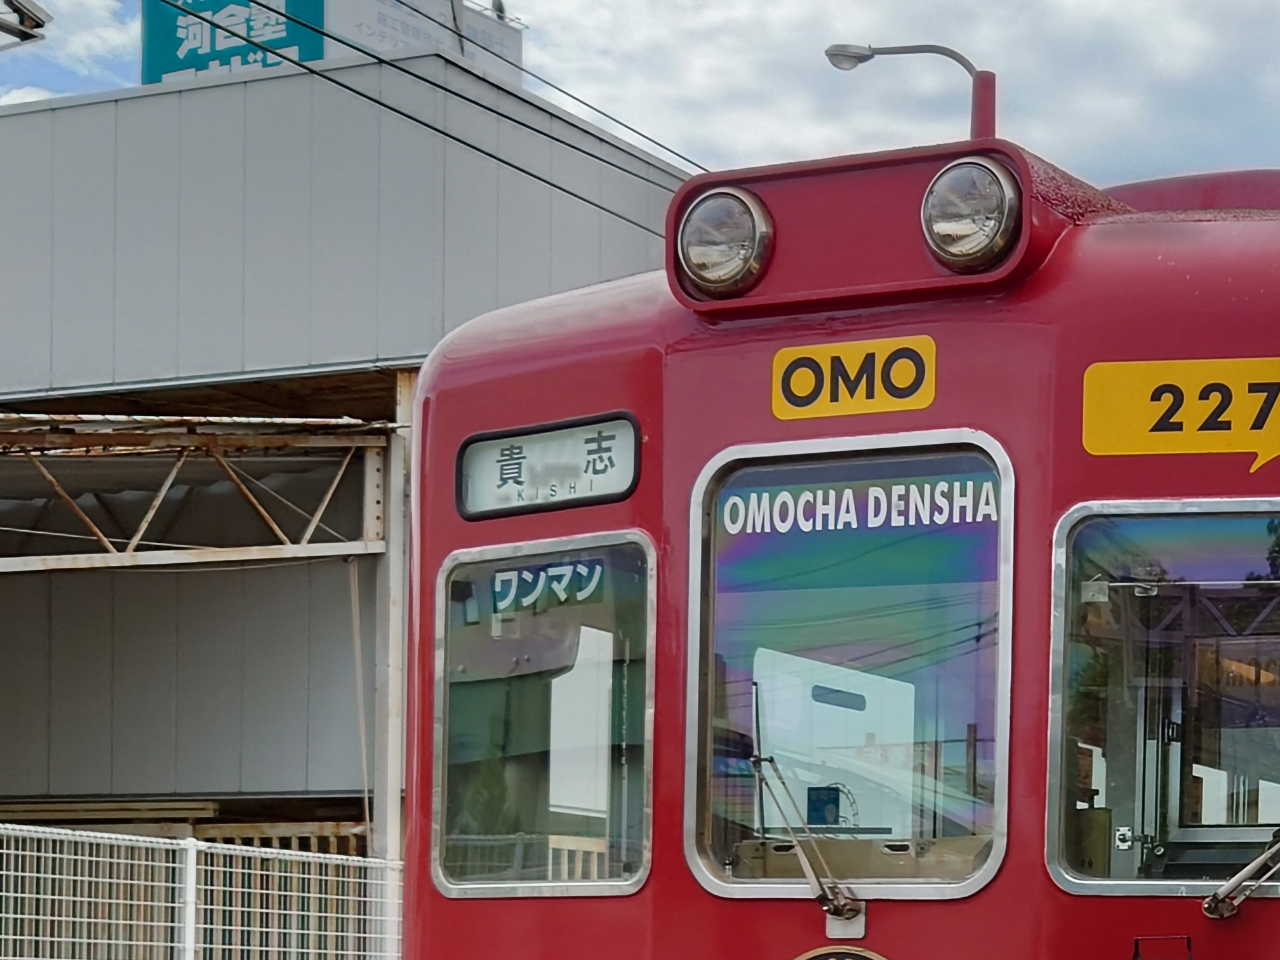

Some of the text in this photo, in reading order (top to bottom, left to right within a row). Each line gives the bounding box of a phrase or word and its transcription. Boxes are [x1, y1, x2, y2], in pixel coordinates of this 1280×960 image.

[176, 0, 287, 59] 河合塾
[781, 347, 926, 407] OMO
[517, 479, 594, 502] KISHI
[723, 480, 998, 535] OMOCHA DENSHA
[494, 563, 603, 610] ワンマン
